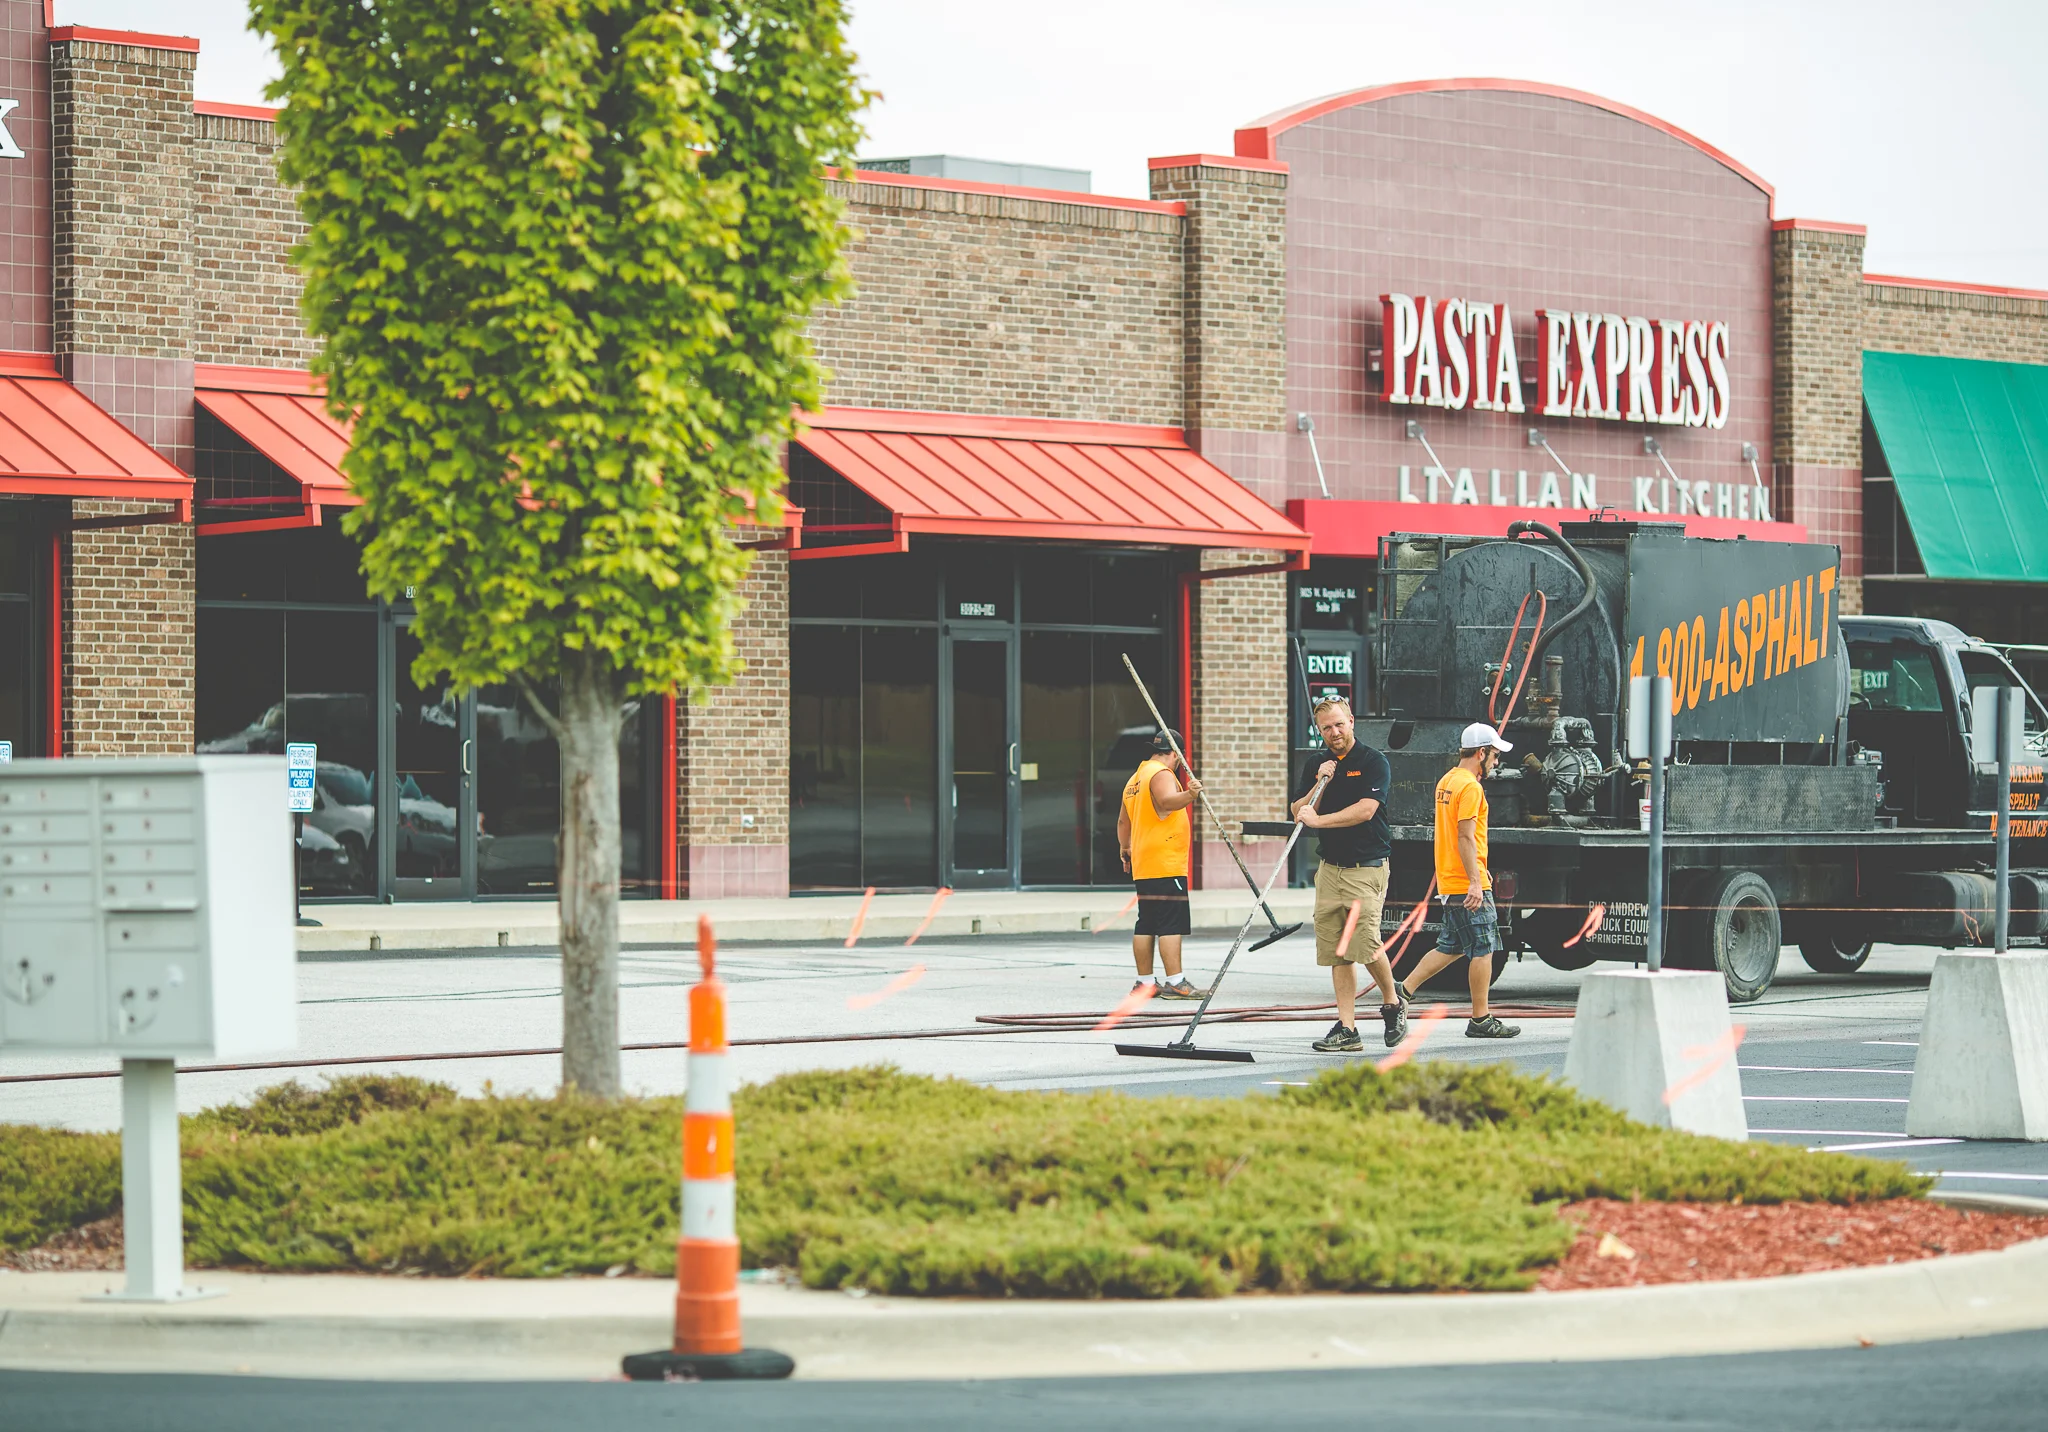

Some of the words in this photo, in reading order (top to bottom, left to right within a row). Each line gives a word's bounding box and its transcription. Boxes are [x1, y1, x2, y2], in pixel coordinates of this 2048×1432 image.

[1380, 293, 1525, 413] PASTA
[1536, 309, 1730, 430] EXPRESS
[1398, 465, 1599, 510] ITALIAN
[1633, 476, 1773, 521] KITCHEN
[1307, 655, 1352, 674] ENTER
[1863, 670, 1889, 689] EXIT
[290, 749, 313, 758] RESERVED
[293, 779, 310, 787] CREEK
[289, 790, 312, 798] CLIENTS
[293, 798, 308, 806] ONLY
[2008, 792, 2041, 811] SPHALT
[1990, 811, 2048, 838] MTENANCE
[1609, 902, 1650, 917] ANDREW
